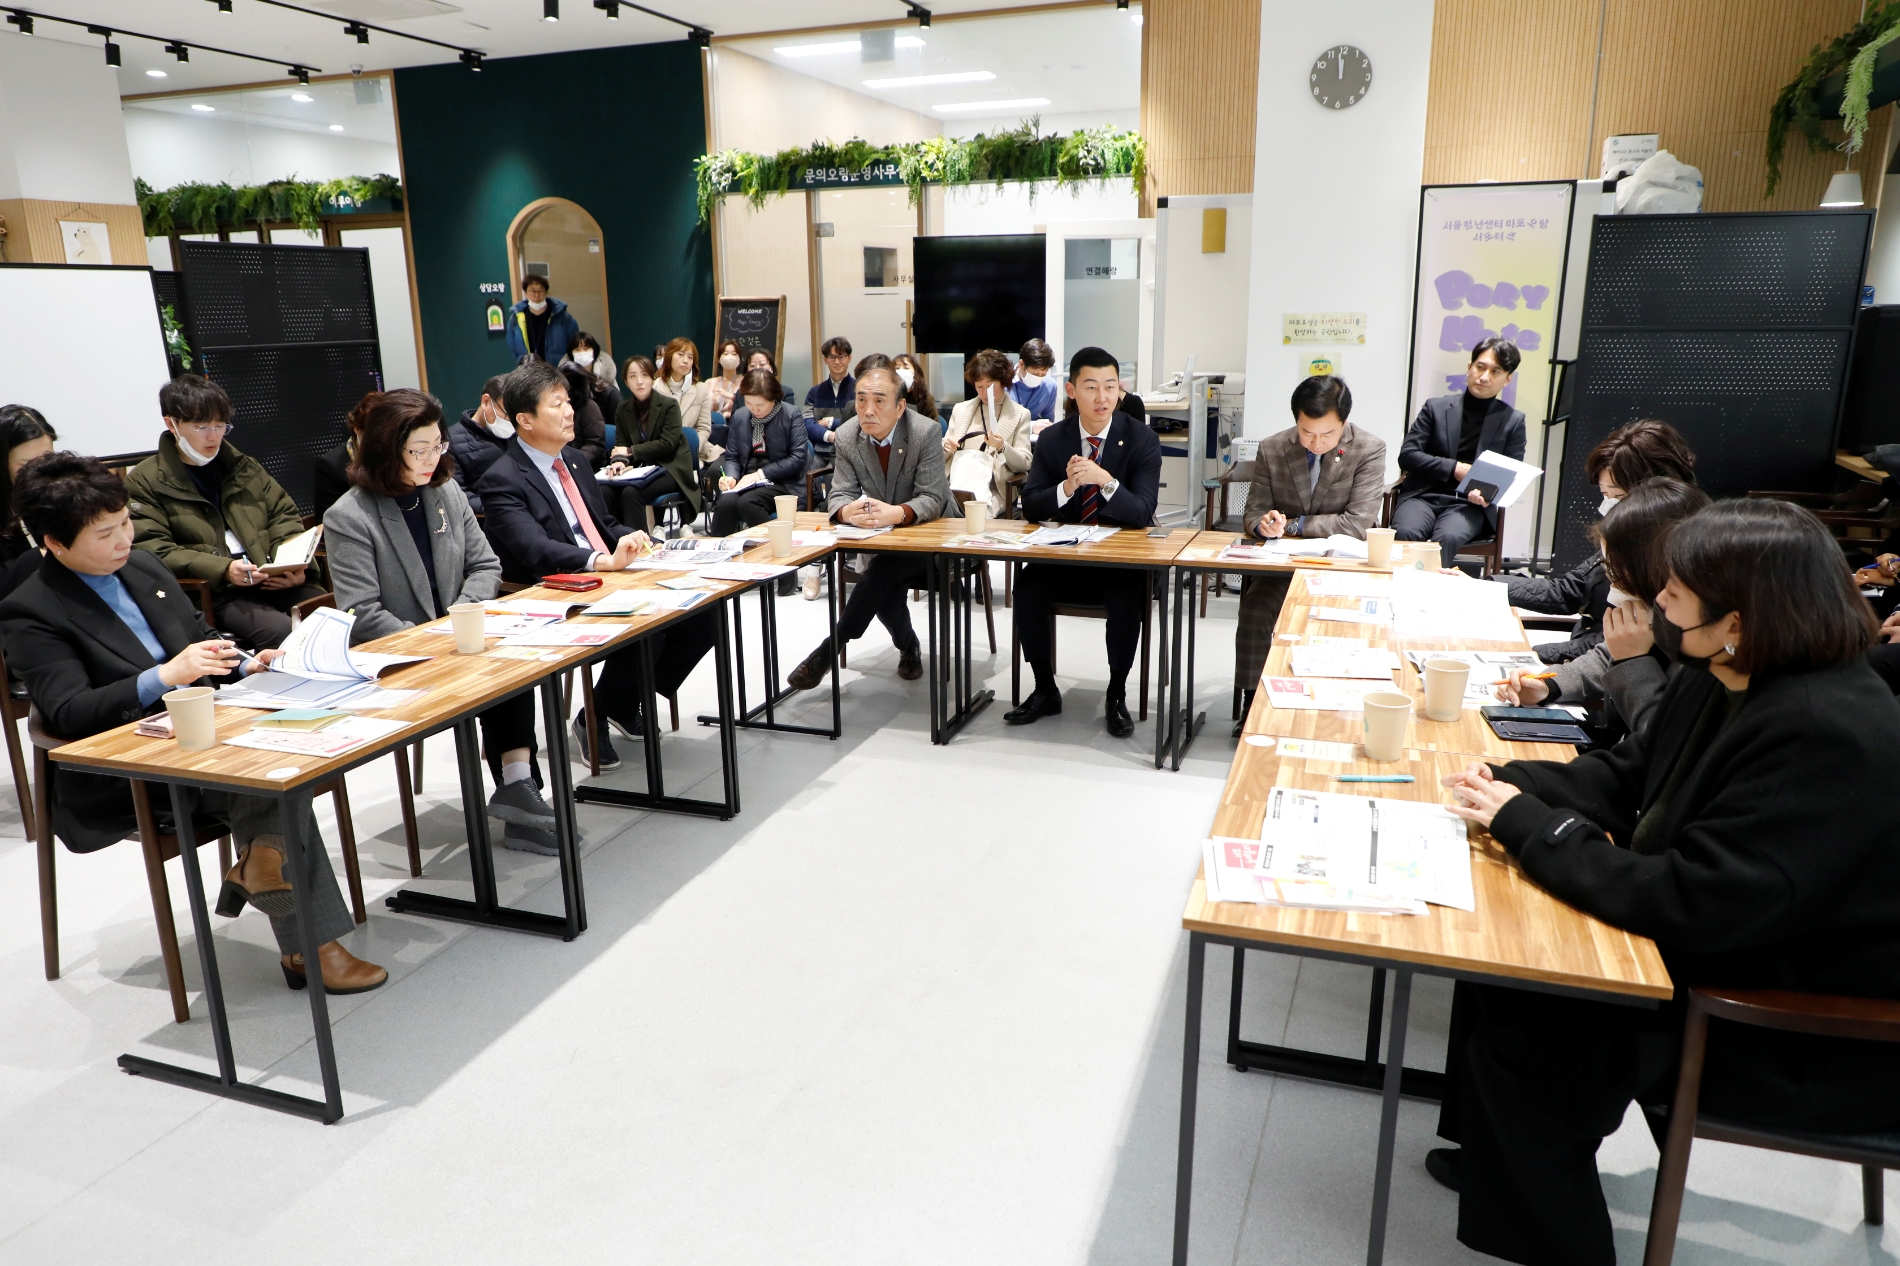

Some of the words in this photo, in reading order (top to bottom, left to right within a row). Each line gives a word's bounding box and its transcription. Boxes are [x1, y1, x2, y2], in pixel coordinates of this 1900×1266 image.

[1327, 50, 1335, 59] 11
[1339, 46, 1349, 55] 12
[1355, 49, 1360, 58] 1
[1316, 60, 1327, 70] 10
[1361, 58, 1369, 68] 2
[1311, 73, 1317, 82] 9
[1365, 72, 1371, 82] 3
[1313, 86, 1320, 96] 8
[1359, 86, 1366, 96] 4
[1322, 96, 1329, 105] 7
[1334, 100, 1341, 109] 6
[1348, 95, 1355, 105] 5
[804, 164, 902, 183] 문의오랑운영사무
[1085, 266, 1118, 276] 연결해랑
